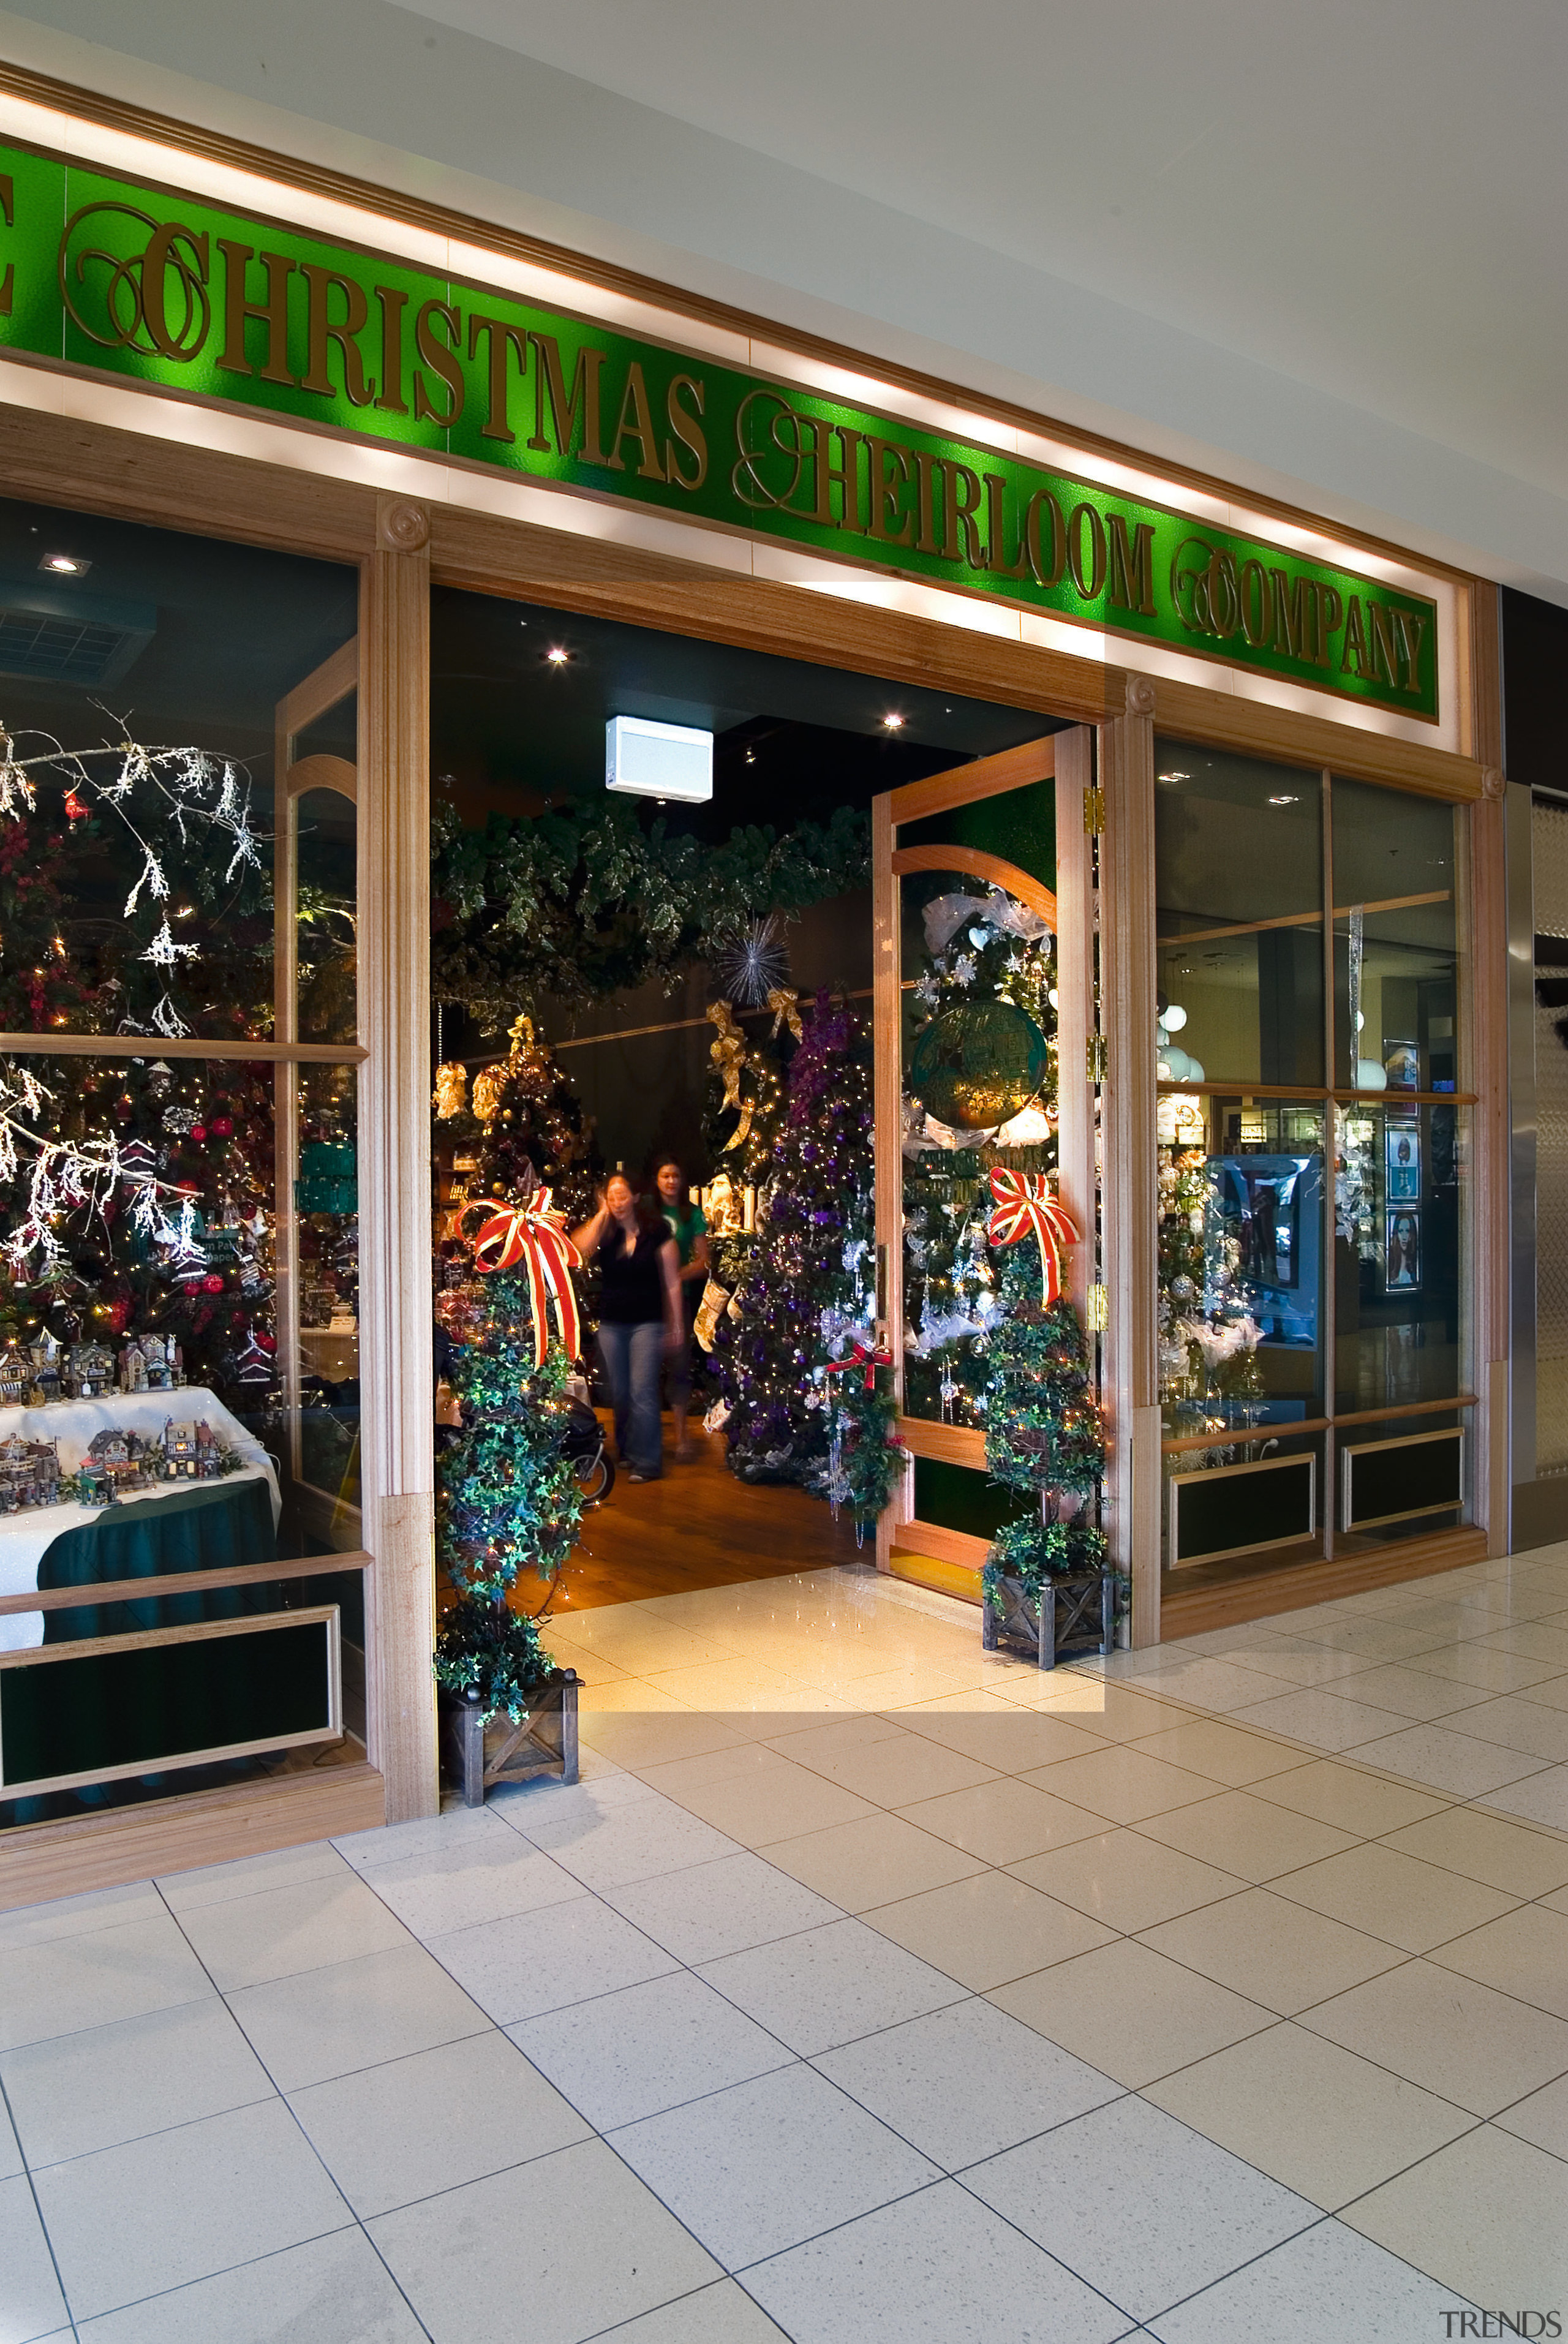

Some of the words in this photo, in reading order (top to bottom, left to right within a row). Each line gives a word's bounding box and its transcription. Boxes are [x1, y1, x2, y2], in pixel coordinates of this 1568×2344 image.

[58, 201, 709, 490] CHRISTMAS
[732, 389, 1157, 617] HEIRLOOM
[1170, 536, 1427, 693] COMPANY
